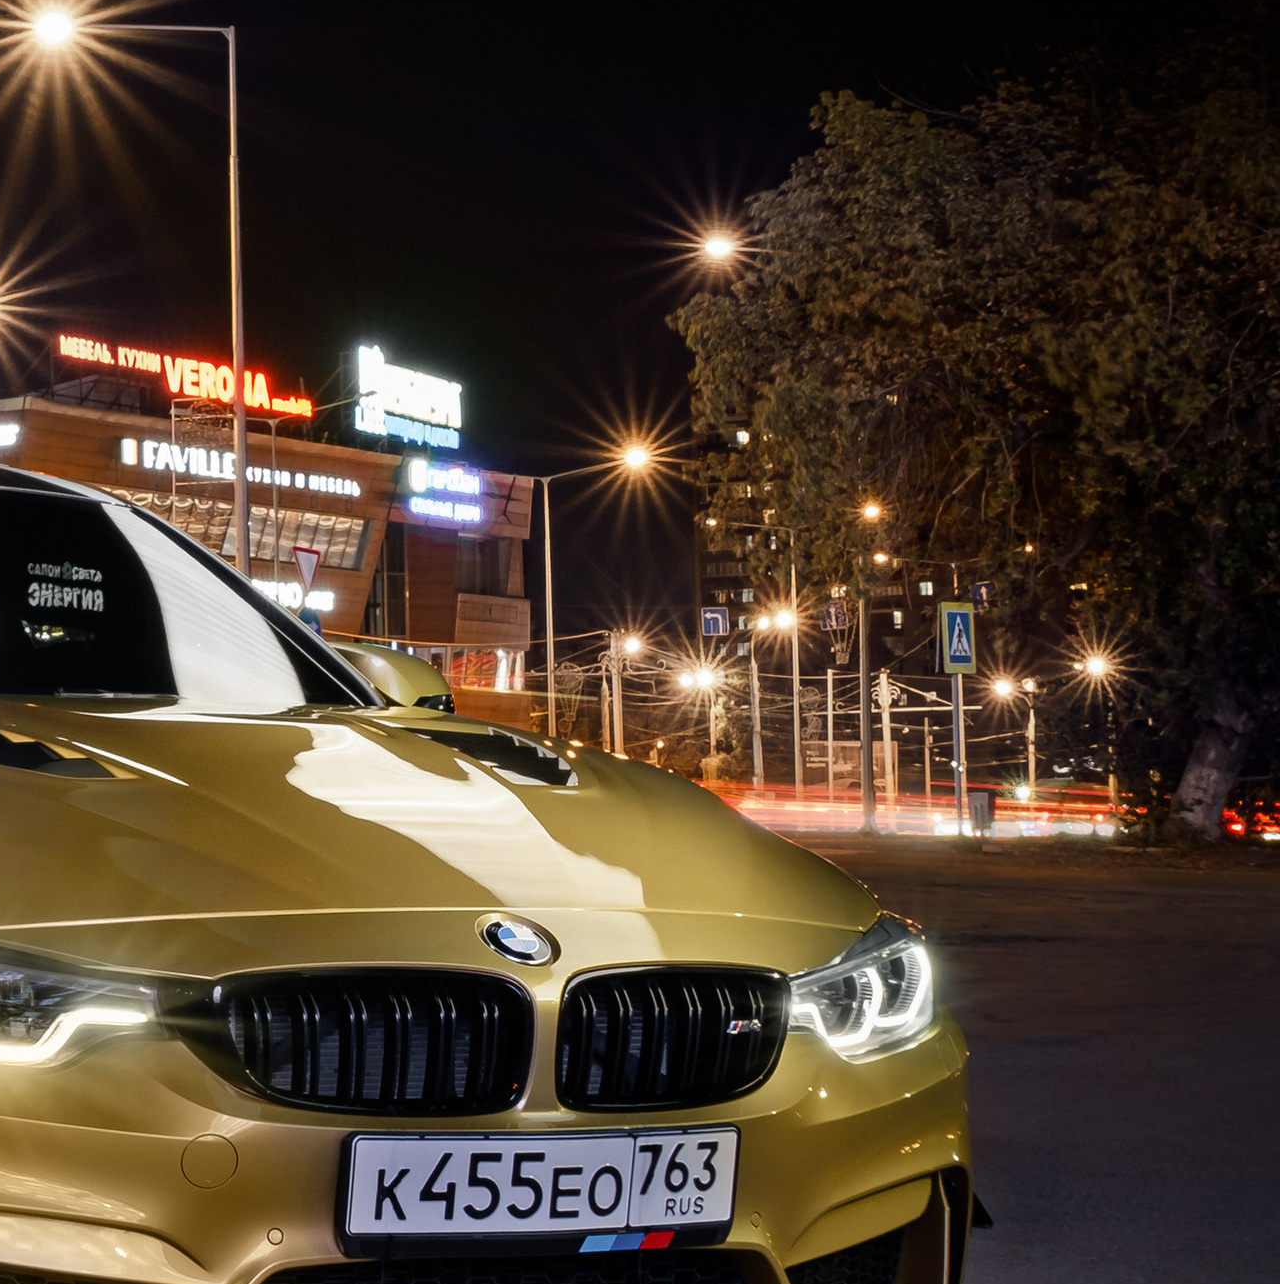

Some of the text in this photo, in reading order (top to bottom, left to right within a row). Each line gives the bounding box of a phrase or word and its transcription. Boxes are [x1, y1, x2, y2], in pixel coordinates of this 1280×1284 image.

[143, 440, 236, 480] FAVILLE
[28, 562, 102, 582] САЛОН СВЕТА
[28, 582, 104, 612] ЭНЕРГИЯ
[374, 1141, 719, 1220] К455ЕО 763
[664, 1197, 705, 1216] RUS
